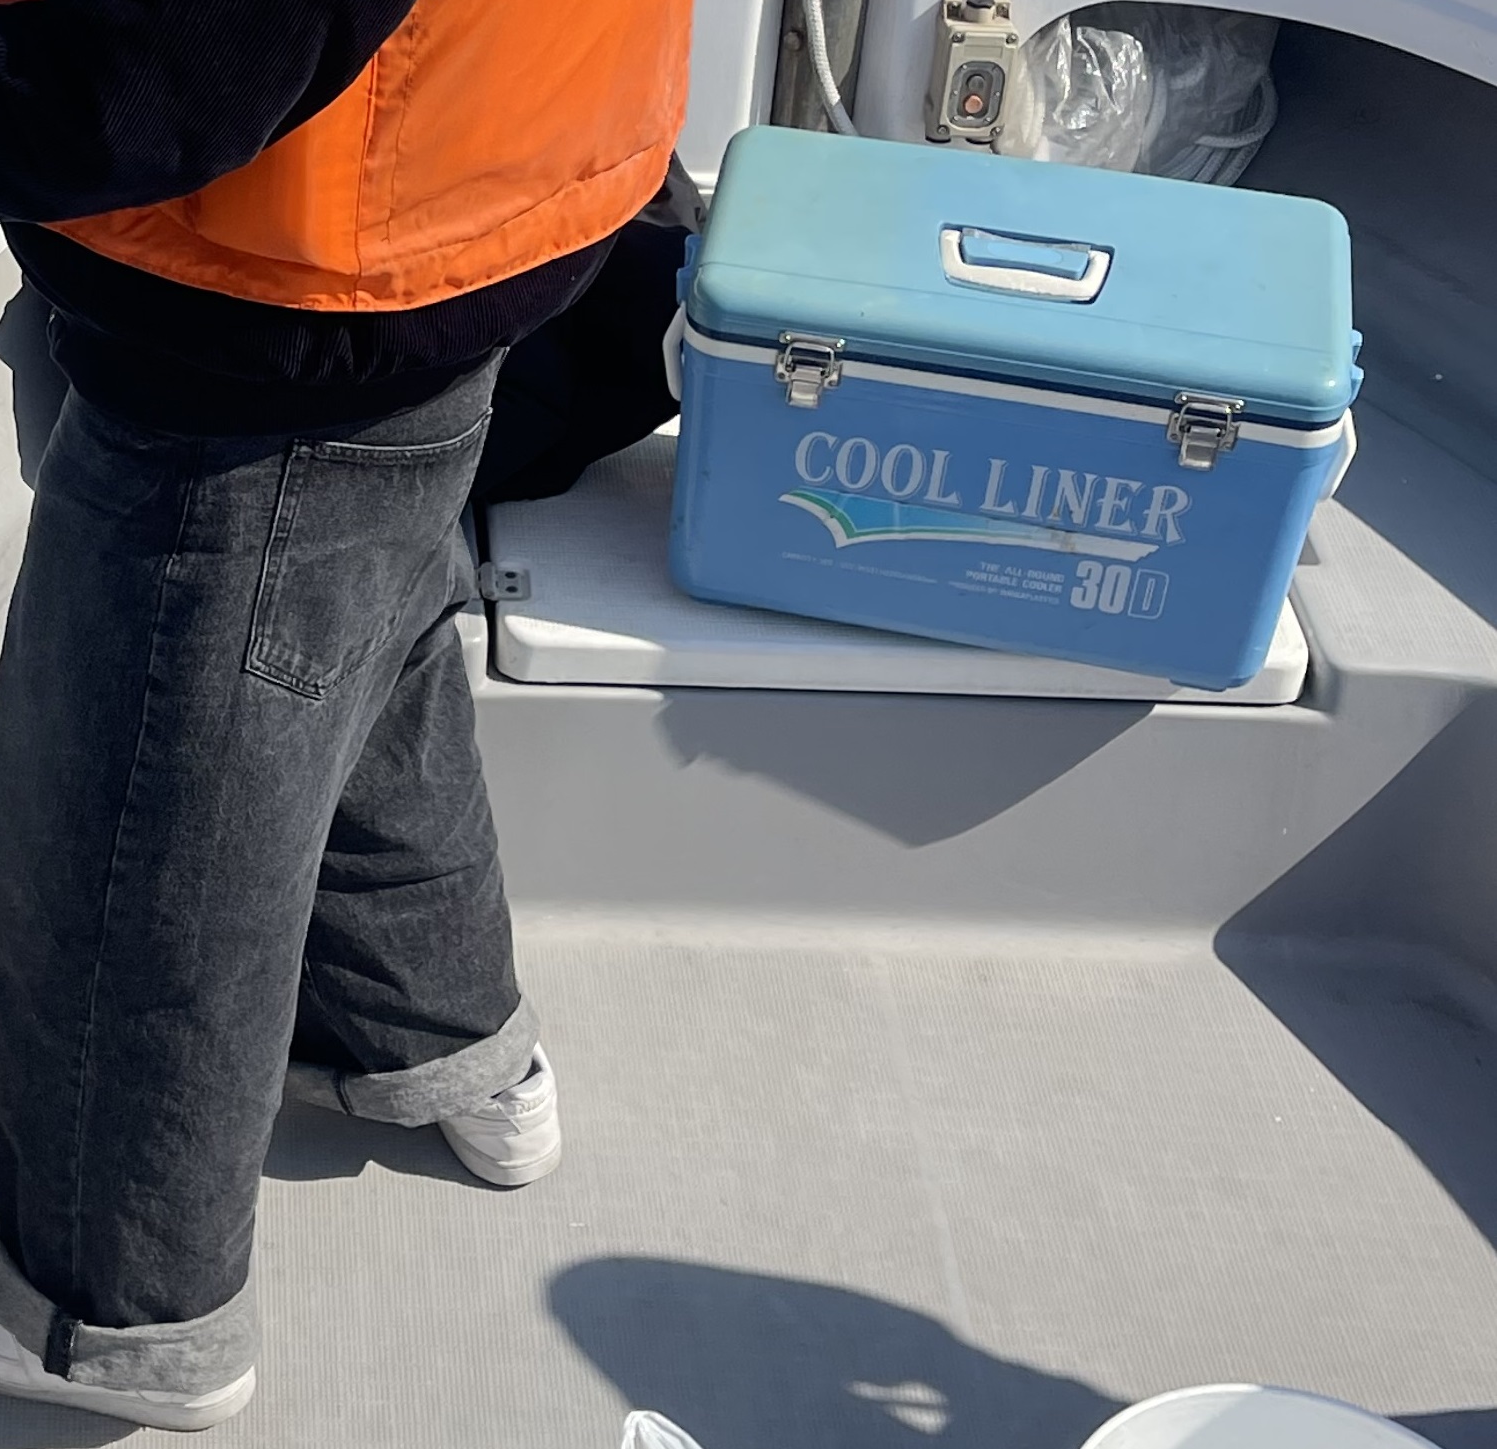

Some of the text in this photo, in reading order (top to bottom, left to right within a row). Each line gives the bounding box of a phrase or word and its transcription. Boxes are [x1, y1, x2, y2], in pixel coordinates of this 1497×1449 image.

[795, 431, 1192, 545] COOL LINER
[980, 561, 1000, 574] THE
[965, 570, 1063, 594] PORTABLE COOLER
